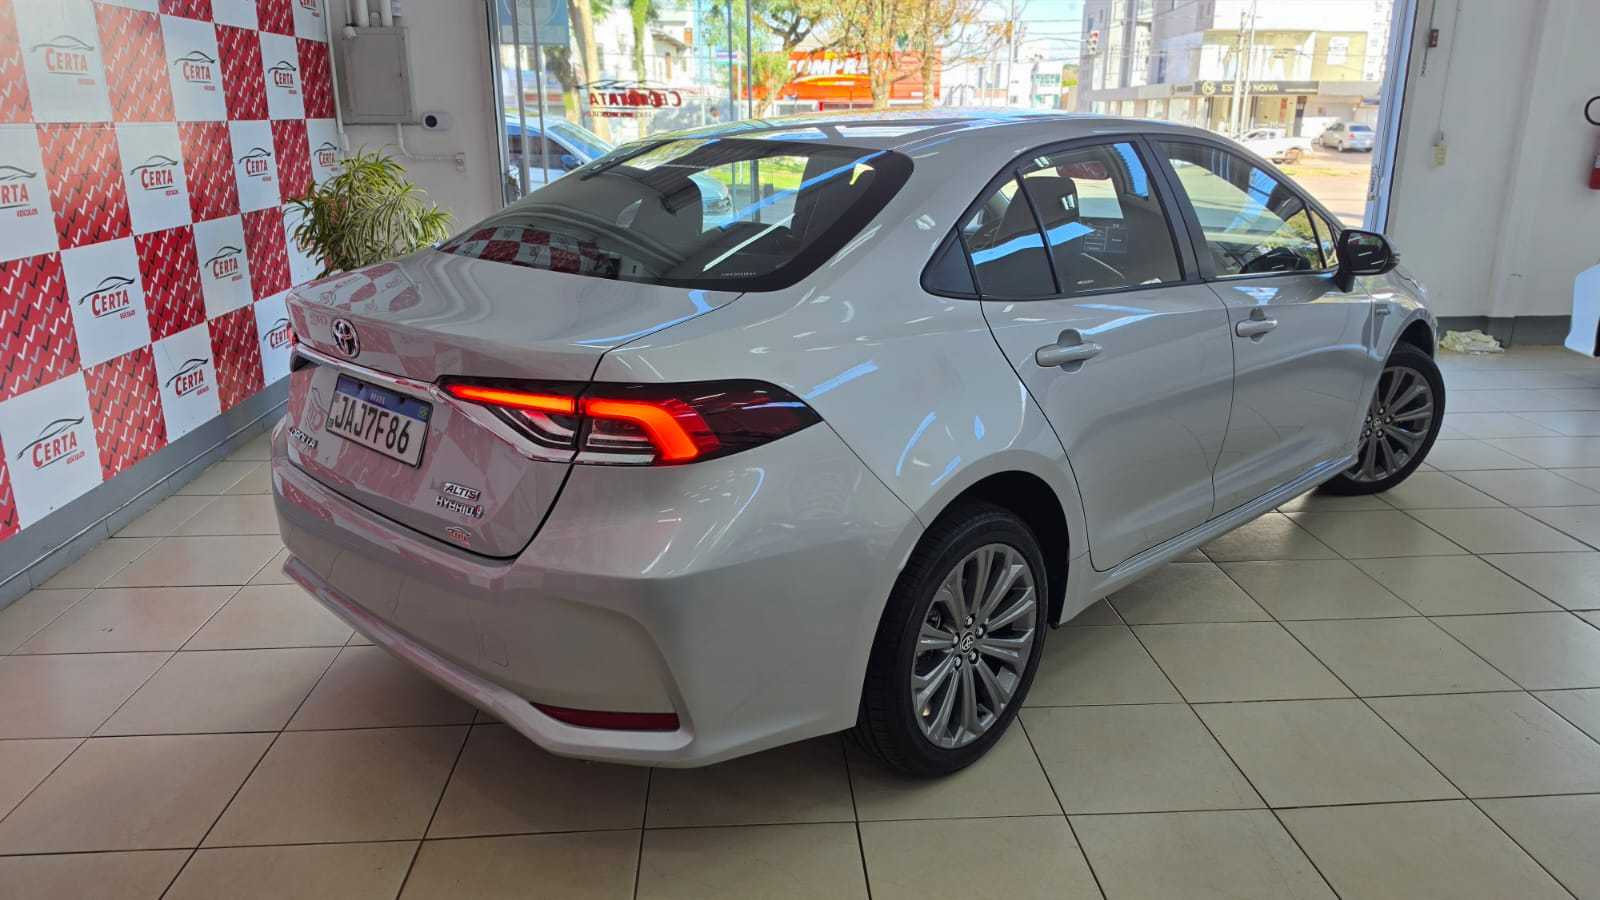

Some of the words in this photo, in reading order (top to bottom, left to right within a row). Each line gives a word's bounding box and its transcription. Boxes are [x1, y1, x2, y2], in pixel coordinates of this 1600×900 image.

[46, 48, 88, 72] CERTA
[182, 62, 211, 80] CERTA
[274, 70, 294, 85] CERTA
[246, 159, 268, 175] CERTA
[319, 151, 336, 166] CERTA
[141, 168, 174, 188] CERTA
[0, 183, 29, 205] RTA
[213, 258, 238, 277] CERTA
[91, 288, 129, 316] CERTA
[175, 368, 204, 396] CERTA
[334, 396, 410, 454] JAJ7F86
[32, 431, 77, 467] CERTA
[445, 484, 478, 501] ALTIS
